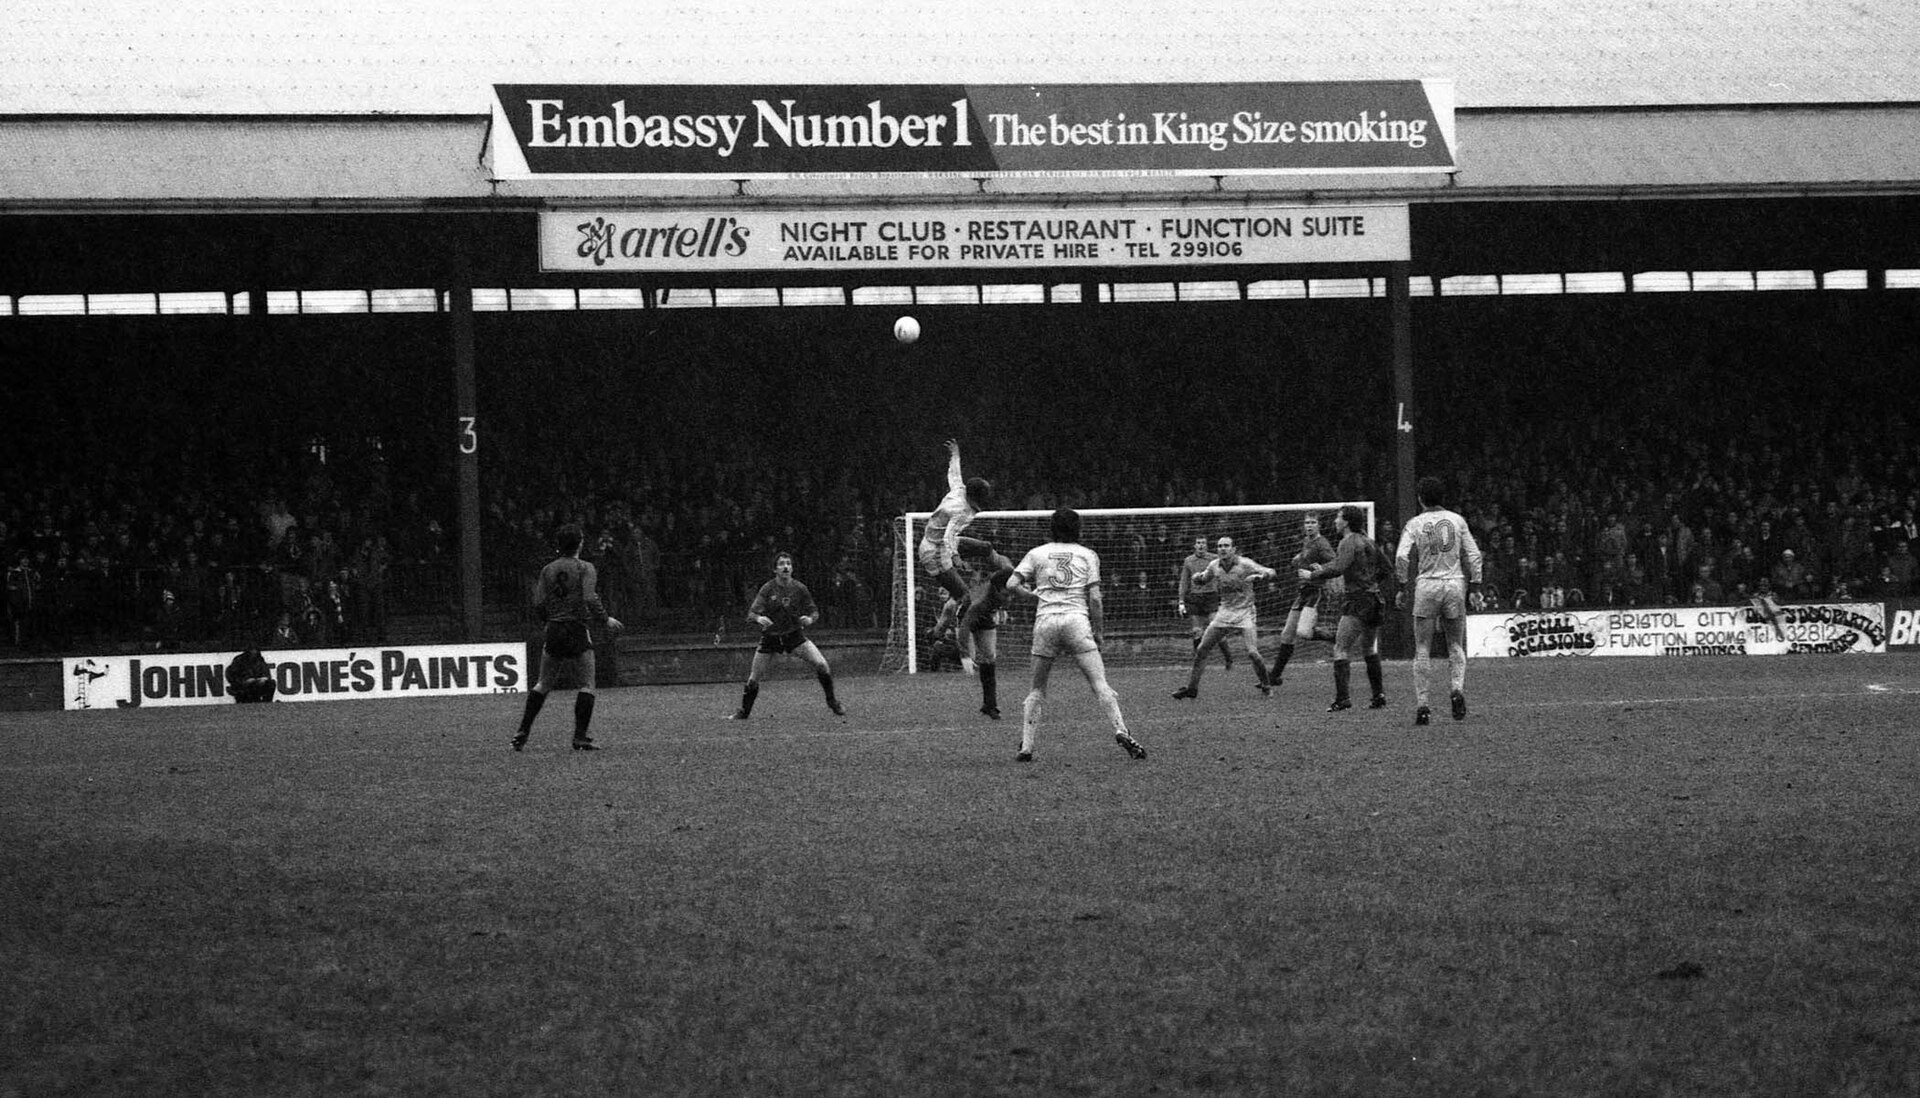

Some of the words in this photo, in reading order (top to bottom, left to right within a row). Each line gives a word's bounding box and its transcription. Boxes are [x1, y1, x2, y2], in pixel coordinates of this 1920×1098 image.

[526, 99, 746, 157] Embassy
[752, 99, 947, 148] Number
[952, 98, 972, 146] 1
[989, 113, 1046, 146] The
[1048, 113, 1114, 146] best
[1116, 113, 1149, 145] in
[1152, 112, 1228, 151] King
[1232, 111, 1296, 144] Size
[1300, 110, 1427, 148] smoking
[781, 222, 867, 242] NIGHT
[878, 221, 946, 242] CLUB
[968, 219, 1136, 241] RESTAURANT
[1161, 217, 1291, 239] FUNCTION
[1302, 216, 1365, 236] SUITE
[783, 245, 898, 261] AVAILABLE
[909, 244, 950, 260] FOR
[960, 243, 1044, 260] PRIVATE
[1053, 243, 1099, 258] HIRE
[1125, 242, 1159, 258] TEL
[1170, 241, 1243, 257] 299106
[1397, 402, 1413, 433] 4
[459, 416, 477, 454] 3
[1422, 519, 1455, 556] 10
[1048, 552, 1073, 591] 3
[1509, 617, 1574, 642] SPECIAL
[1609, 612, 1685, 630] BRISTOL
[1697, 611, 1738, 627] CITY
[1609, 632, 1687, 648] FUNCTION
[1695, 630, 1746, 645] ROOMS
[116, 652, 375, 708] JOHNONE'S
[381, 650, 519, 691] PAINTS
